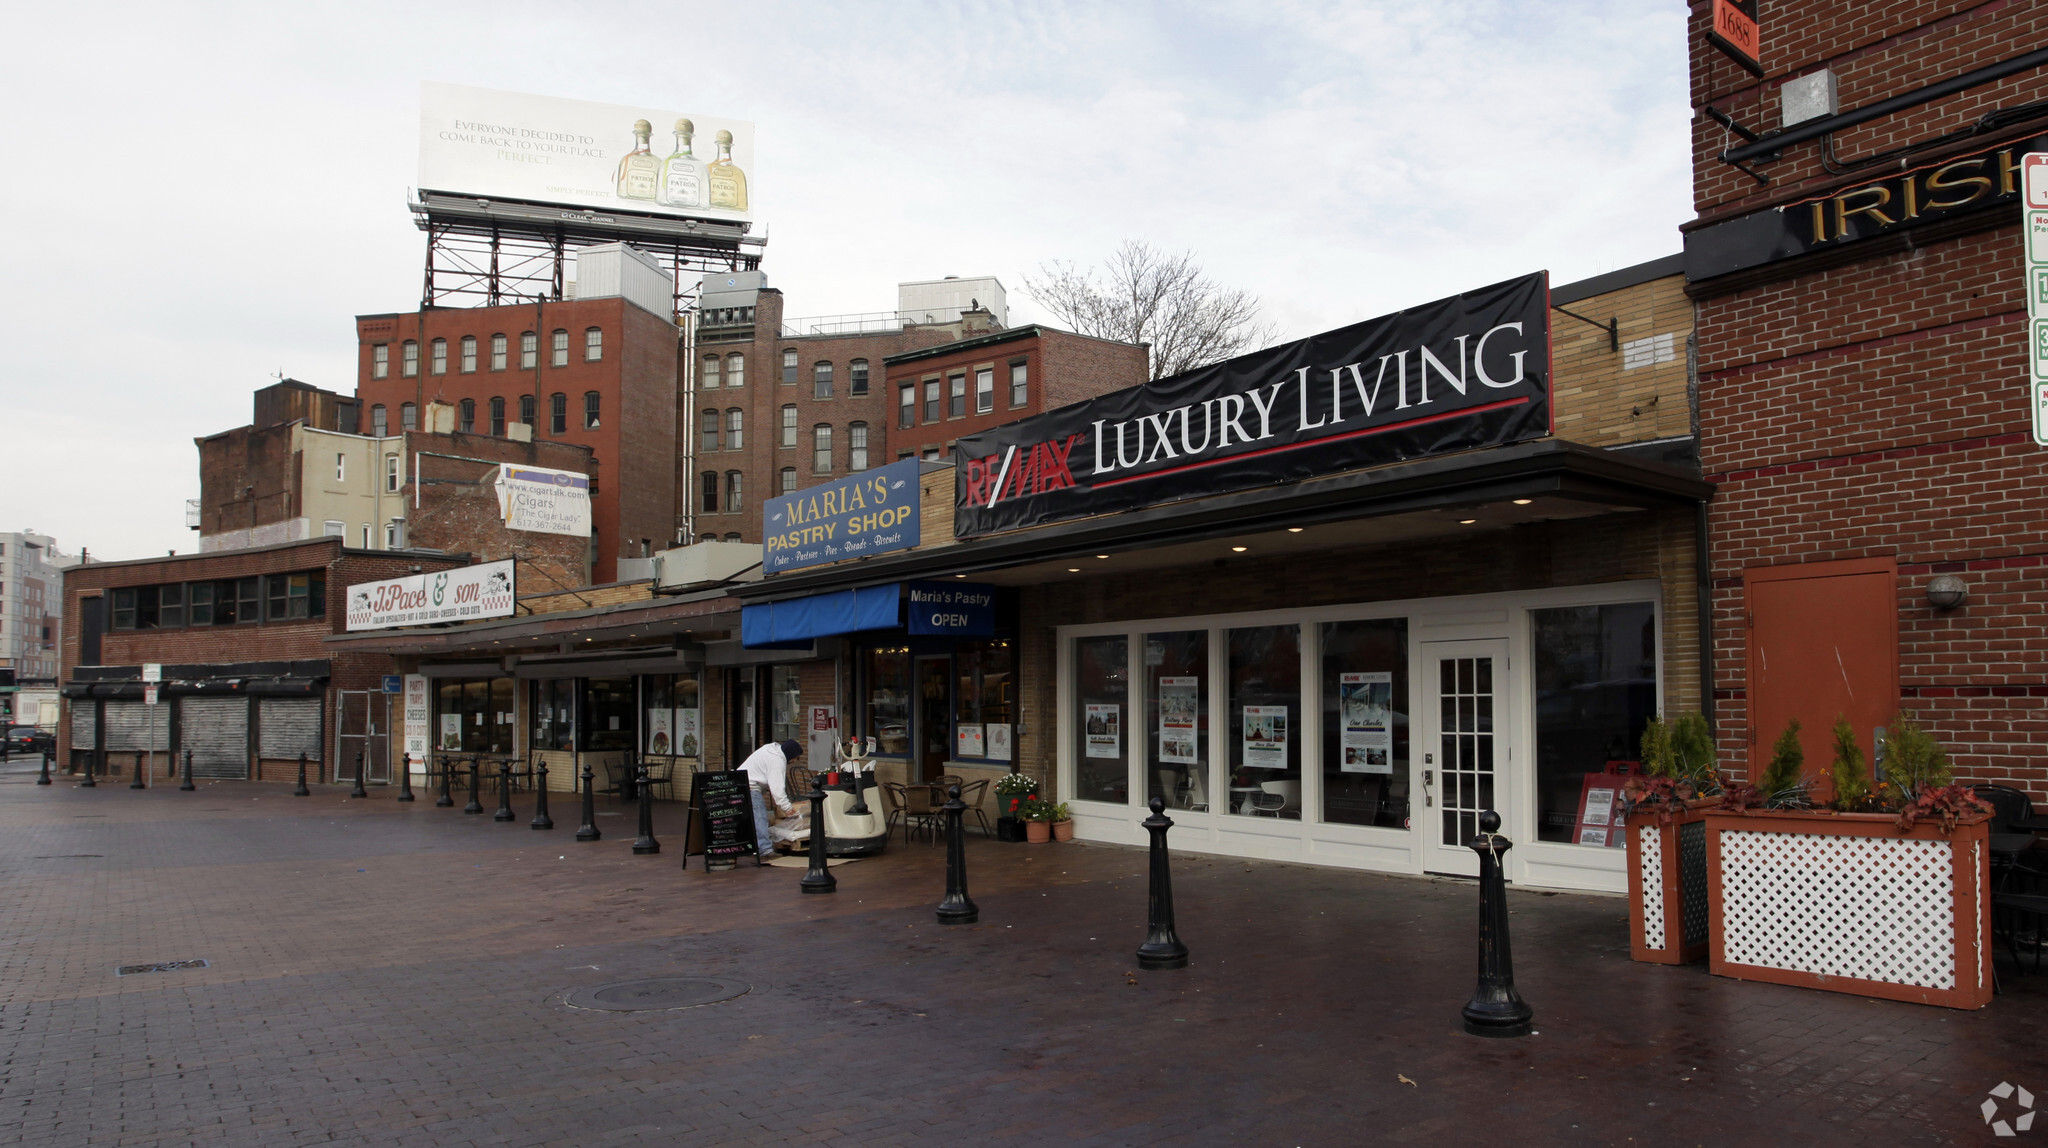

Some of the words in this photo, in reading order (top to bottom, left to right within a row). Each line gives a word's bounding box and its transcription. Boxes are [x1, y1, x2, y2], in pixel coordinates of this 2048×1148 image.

[1721, 7, 1750, 47] 1688
[439, 131, 476, 144] COME
[480, 135, 512, 148] BACK
[515, 140, 531, 150] TO
[534, 142, 568, 155] YOUR
[570, 146, 607, 159] PLACE.
[520, 128, 575, 143] DECIDED
[578, 135, 594, 145] TO
[1091, 381, 1285, 476] LUXURY
[1295, 321, 1529, 432] LIVING
[517, 493, 554, 509] Cigars
[785, 475, 887, 527] MARIA'S
[537, 510, 558, 521] Cigar
[516, 520, 571, 531] 617-367-2644
[767, 522, 837, 553] PASTRY
[847, 505, 912, 535] SHOP
[774, 555, 789, 566] Cakes
[795, 550, 818, 562] Pastries
[825, 544, 838, 556] Pies
[844, 538, 866, 552] Breads
[874, 532, 901, 546] Biscuits
[433, 572, 449, 606] &
[454, 582, 481, 604] son
[911, 589, 952, 603] Maria's
[954, 591, 991, 607] Pastry
[931, 613, 968, 627] OPEN
[409, 680, 424, 692] PARTY
[407, 709, 426, 721] CHEESES
[410, 740, 423, 752] SUBS
